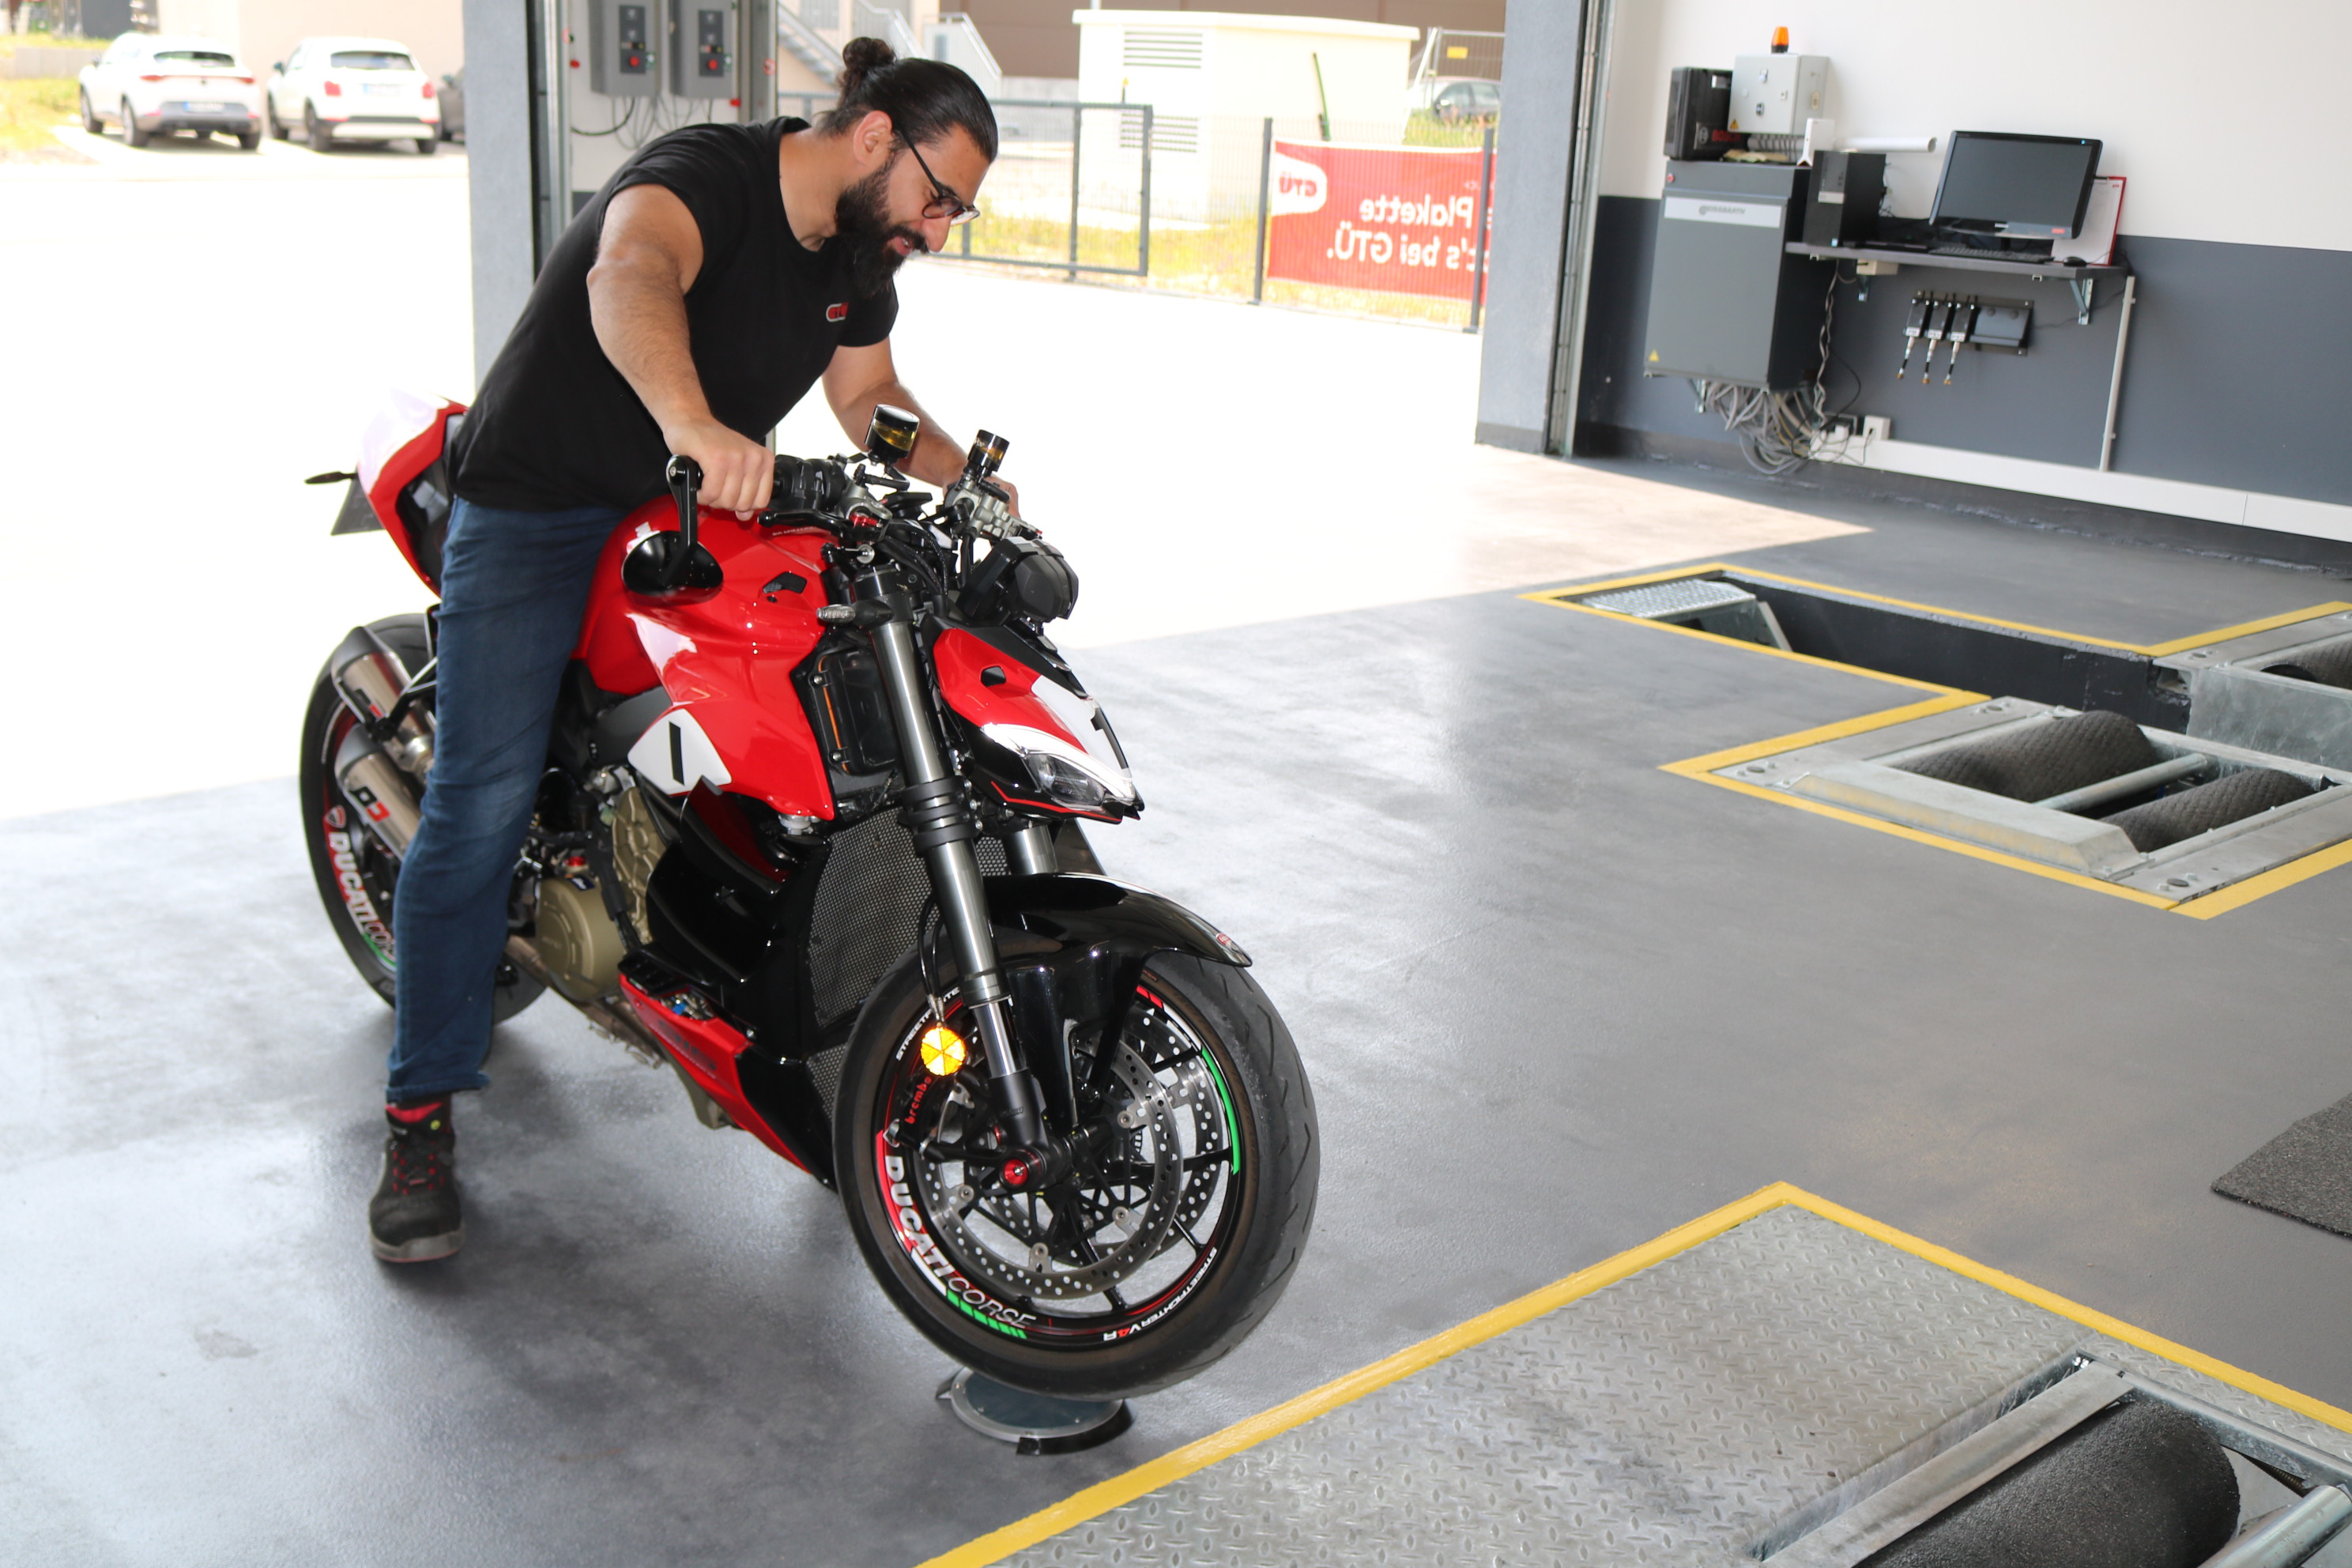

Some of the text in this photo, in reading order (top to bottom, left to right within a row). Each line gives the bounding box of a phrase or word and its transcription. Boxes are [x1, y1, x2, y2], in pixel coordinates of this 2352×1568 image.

[1090, 707, 1129, 770] 1
[328, 832, 379, 923] DUCATI
[905, 1076, 933, 1124] brembo
[885, 1155, 1036, 1329] DUCATI CORSE
[1141, 1246, 1218, 1328] STREETFIGHTER
